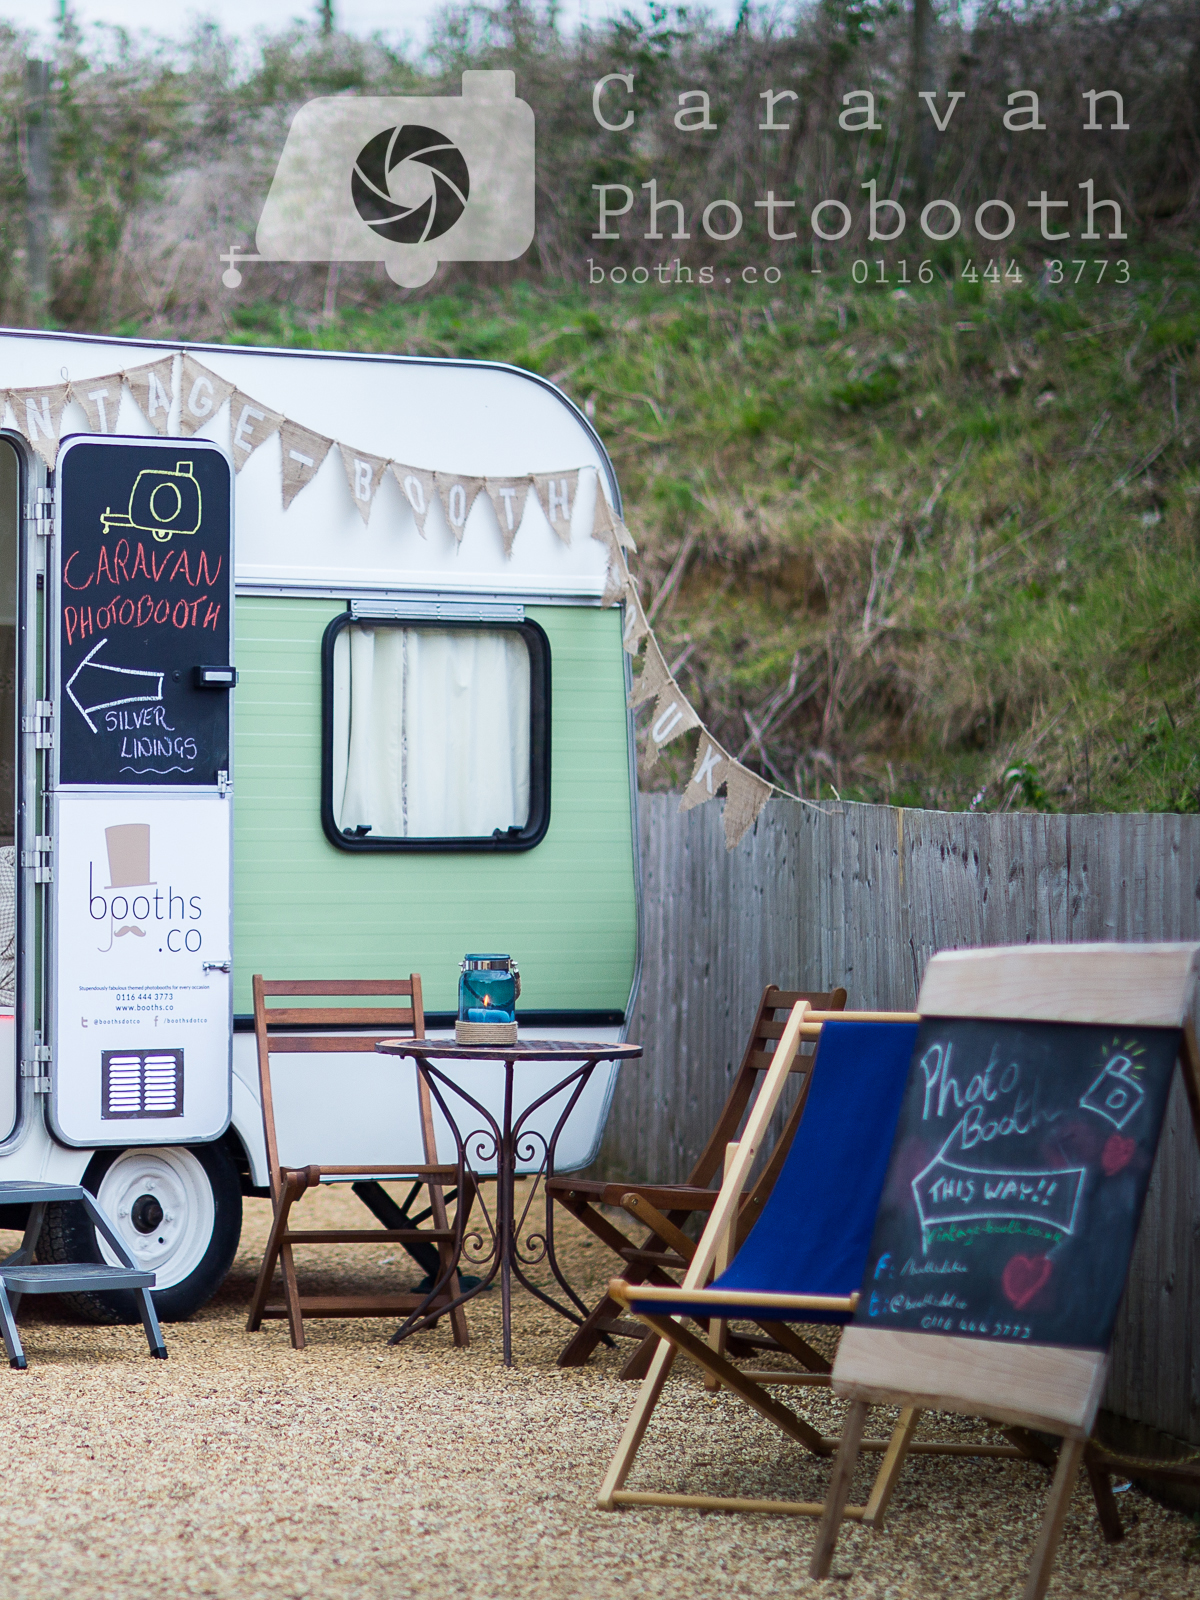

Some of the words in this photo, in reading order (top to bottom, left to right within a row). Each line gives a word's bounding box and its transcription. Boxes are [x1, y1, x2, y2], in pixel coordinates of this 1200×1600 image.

[64, 539, 222, 590] CARAVAN
[64, 595, 220, 646] PHOTOBOOTH
[105, 705, 175, 731] SILVER
[120, 737, 198, 761] LININGS
[89, 861, 203, 921] booths
[157, 928, 203, 953] .co
[115, 993, 136, 1001] 0116
[154, 993, 174, 1001] 3773
[115, 1003, 174, 1011] www.booths.co
[919, 1041, 1019, 1120] Photo
[928, 1175, 975, 1204] THIS
[983, 1177, 1058, 1206] WAY!!
